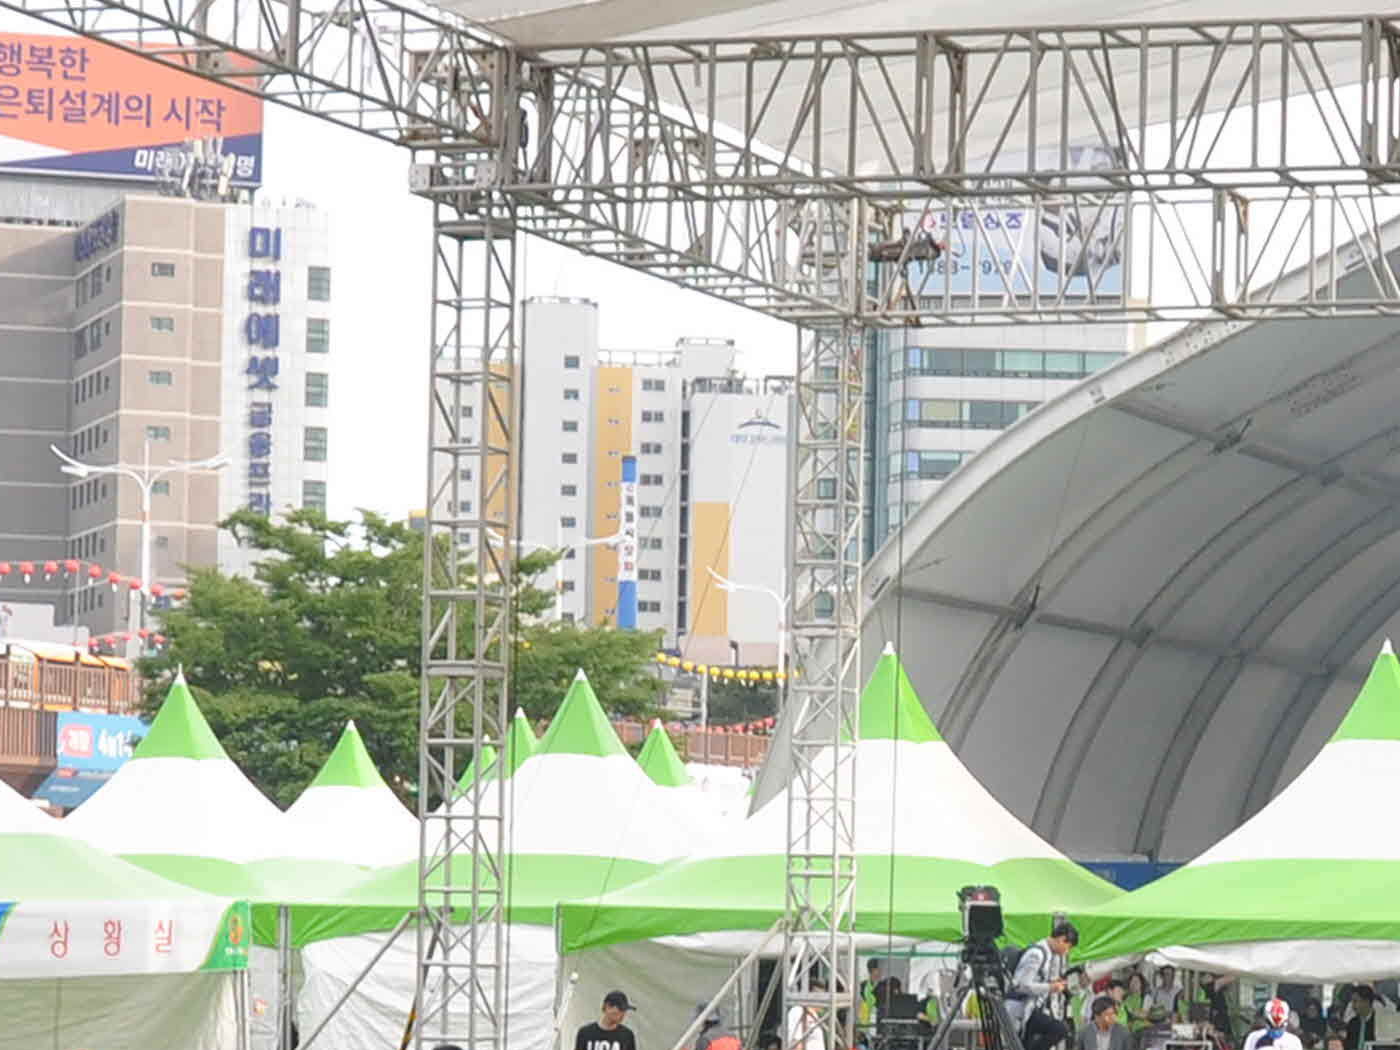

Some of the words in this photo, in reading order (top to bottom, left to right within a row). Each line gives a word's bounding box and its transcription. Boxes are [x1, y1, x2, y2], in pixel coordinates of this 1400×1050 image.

[162, 96, 227, 132] 시작
[50, 919, 71, 959] 상
[103, 919, 124, 957] 황
[154, 919, 174, 954] 실
